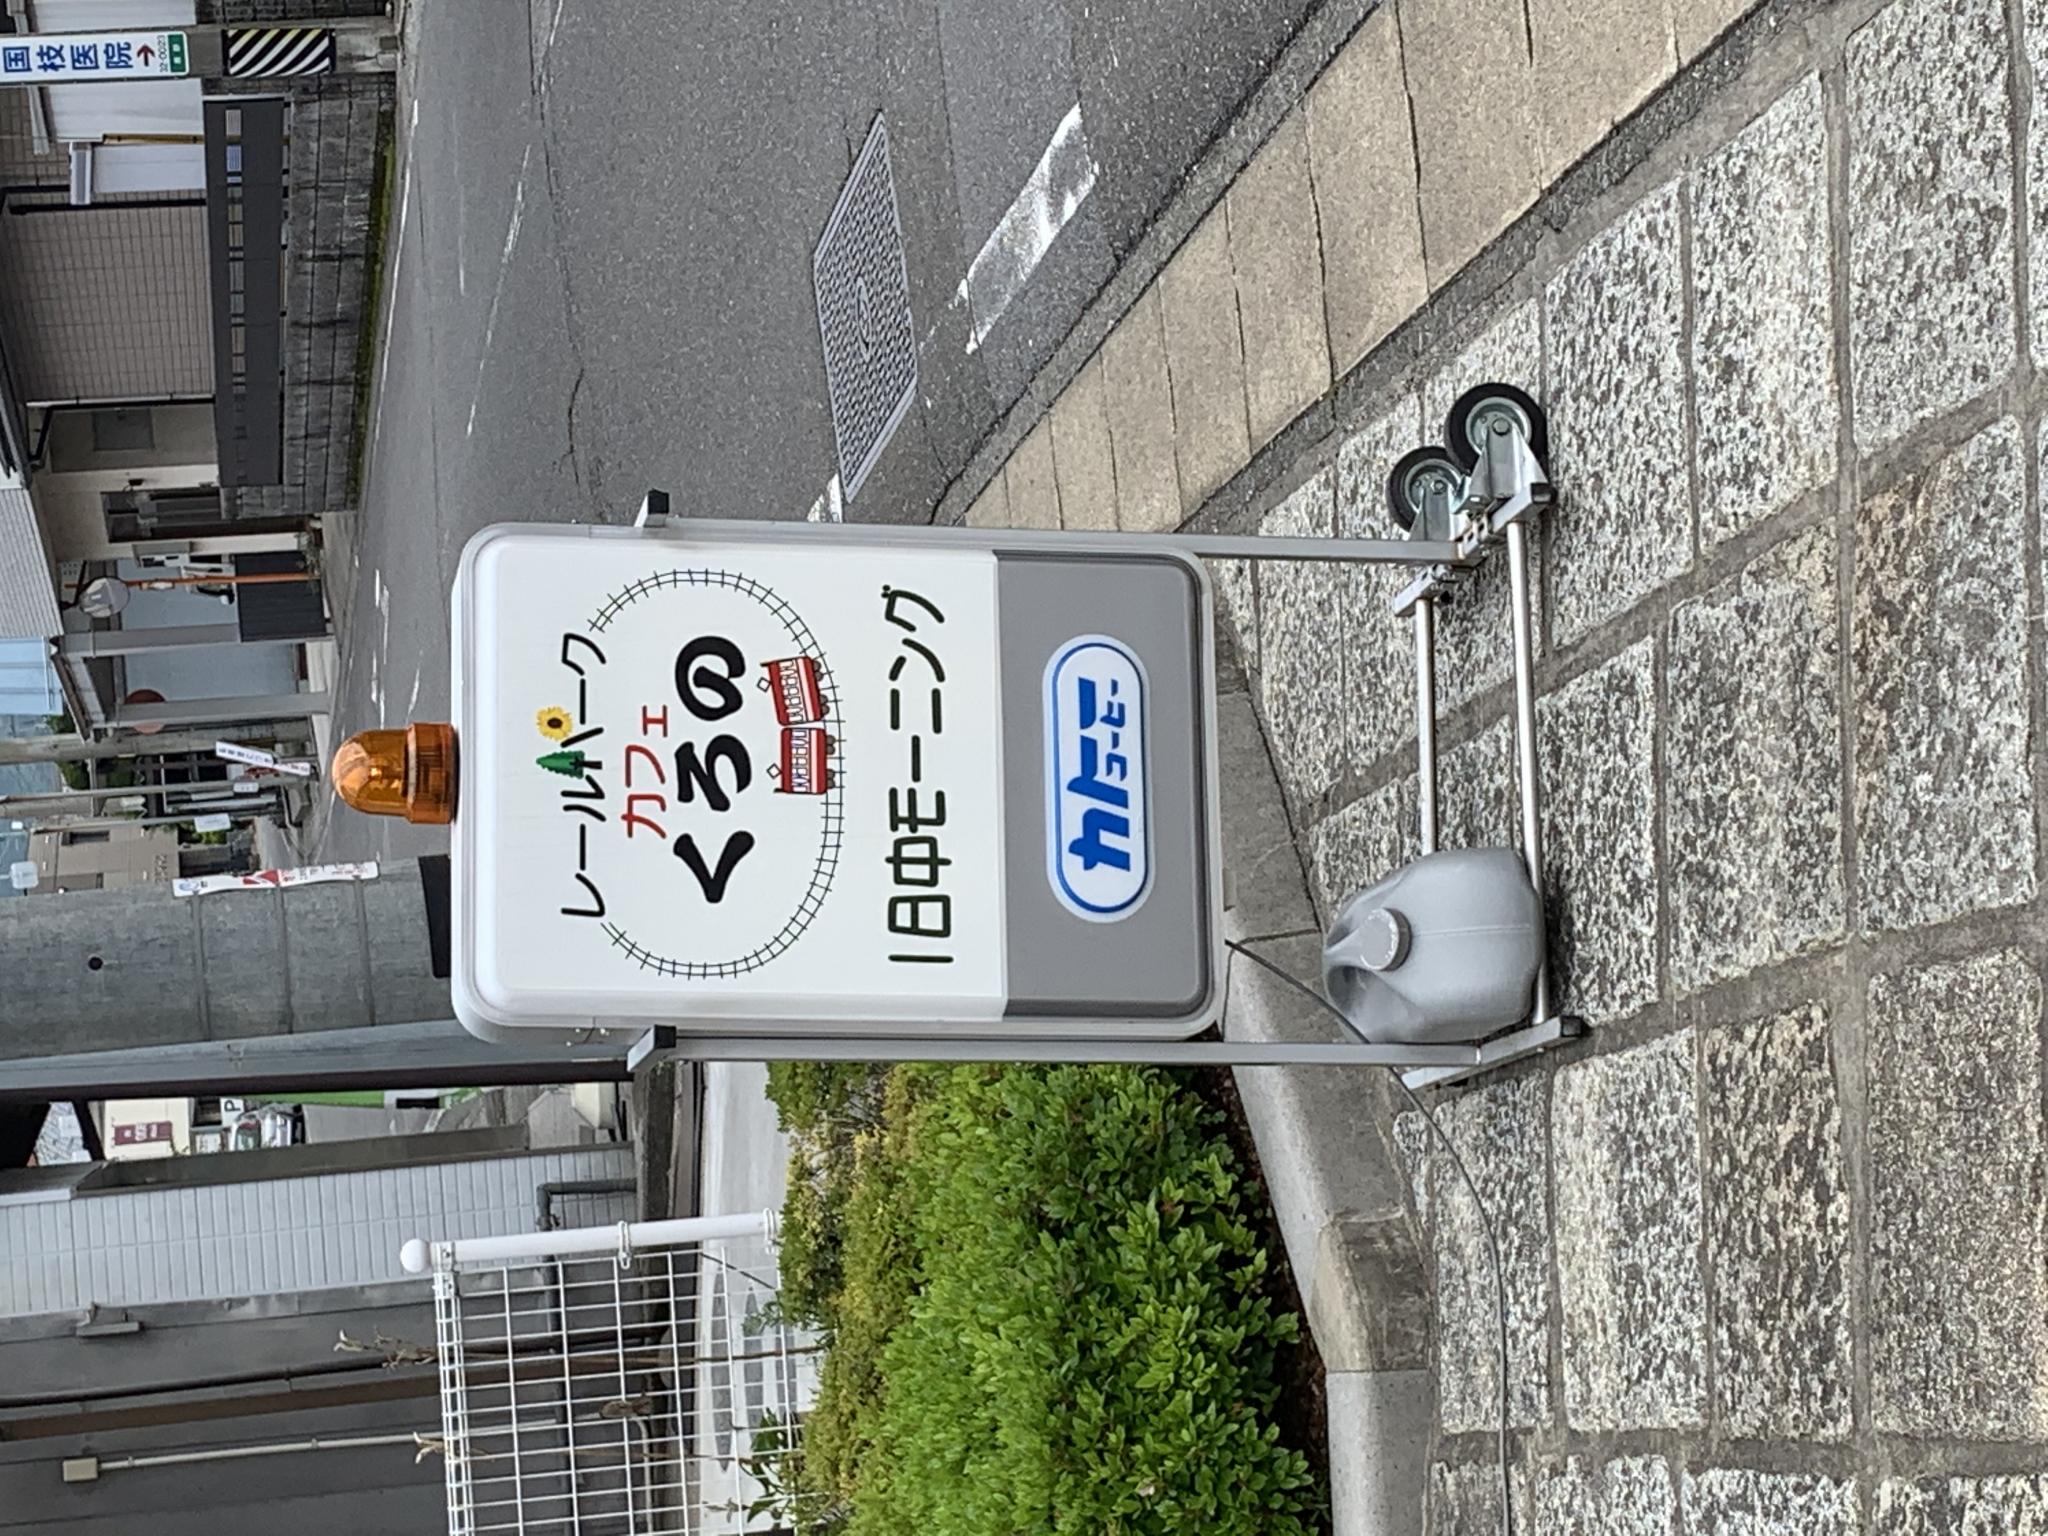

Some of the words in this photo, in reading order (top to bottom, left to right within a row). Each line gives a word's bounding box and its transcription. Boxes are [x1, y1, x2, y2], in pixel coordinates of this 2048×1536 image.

[2, 41, 134, 73] 国枝医院
[538, 632, 607, 920] レールパーク
[621, 704, 668, 840] カフェ
[673, 635, 755, 904] くろの
[1100, 678, 1128, 782] コーヒー
[223, 1099, 241, 1113] P
